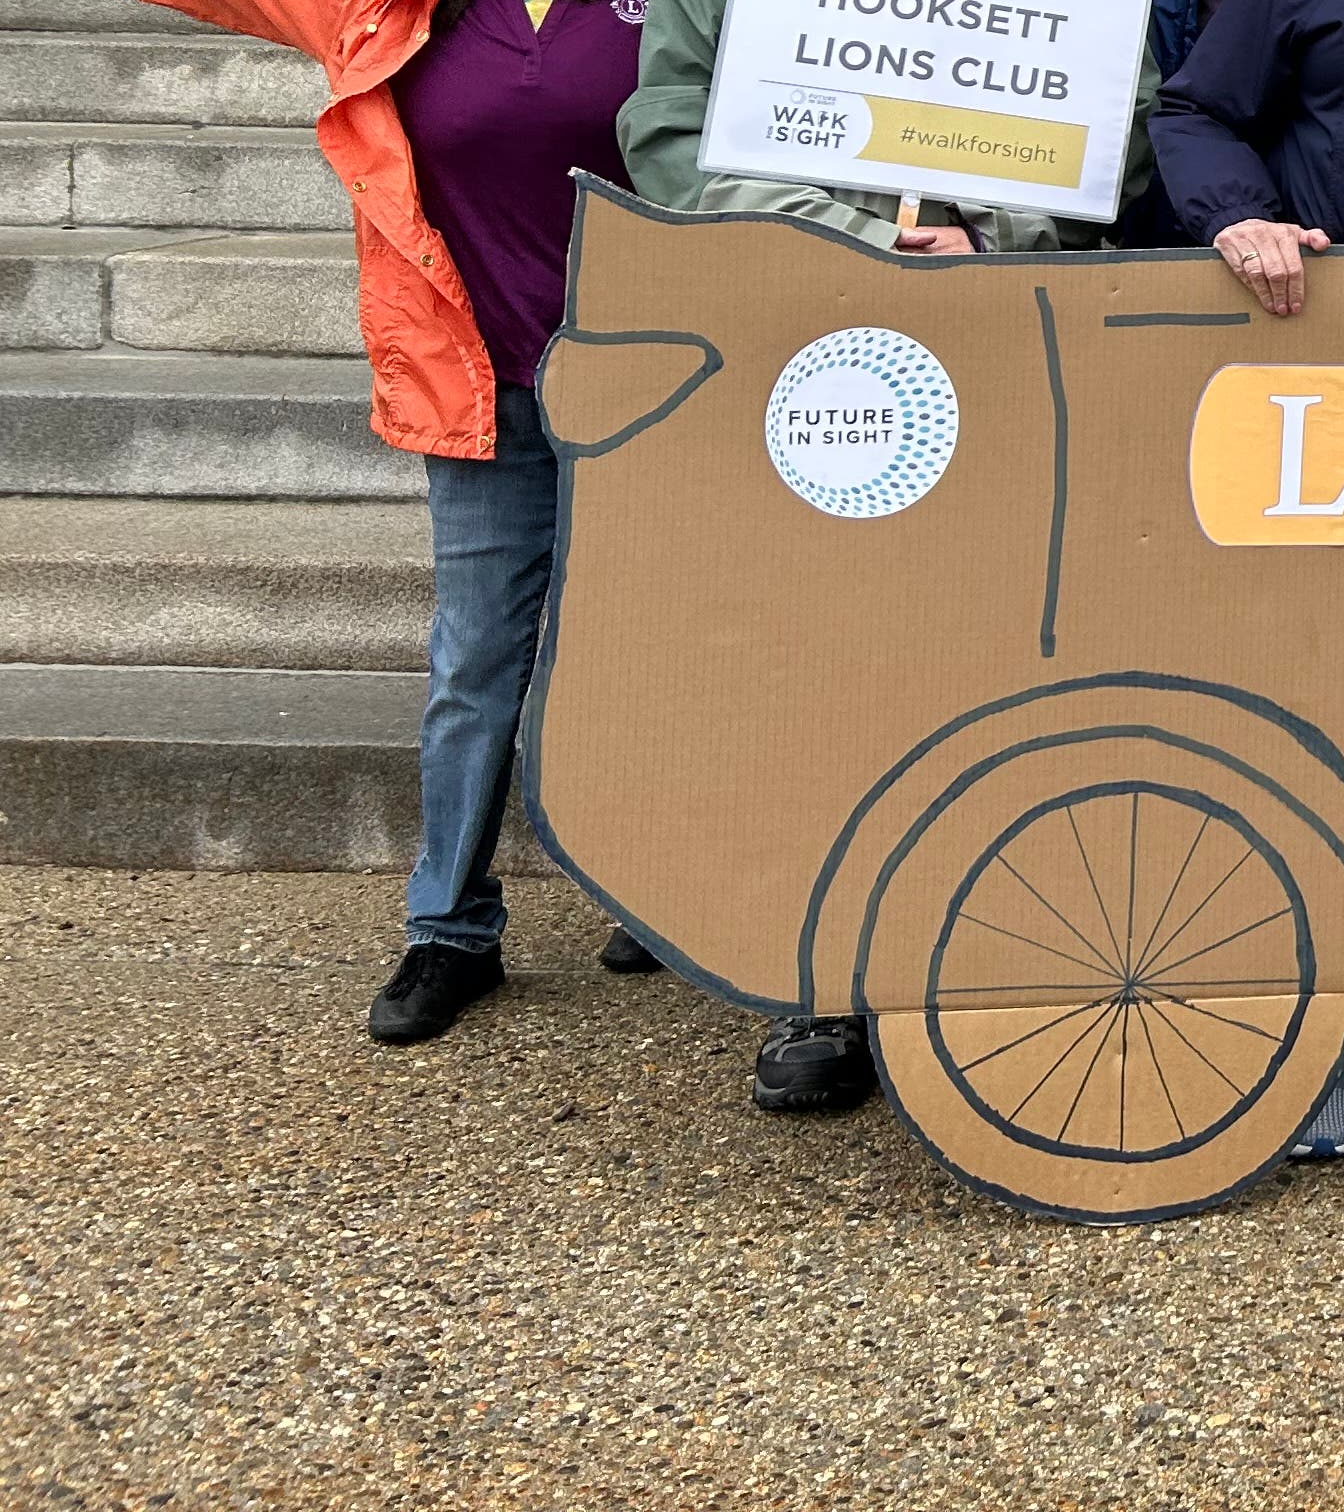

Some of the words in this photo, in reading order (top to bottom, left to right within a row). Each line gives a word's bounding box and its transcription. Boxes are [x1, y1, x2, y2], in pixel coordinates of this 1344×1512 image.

[627, 0, 639, 14] L
[795, 33, 935, 81] LIONS
[951, 56, 1070, 101] CLUB
[900, 126, 1057, 165] #walkforsight
[788, 408, 894, 426] FUTURE
[789, 431, 811, 445] IN
[823, 430, 893, 444] SIGHT
